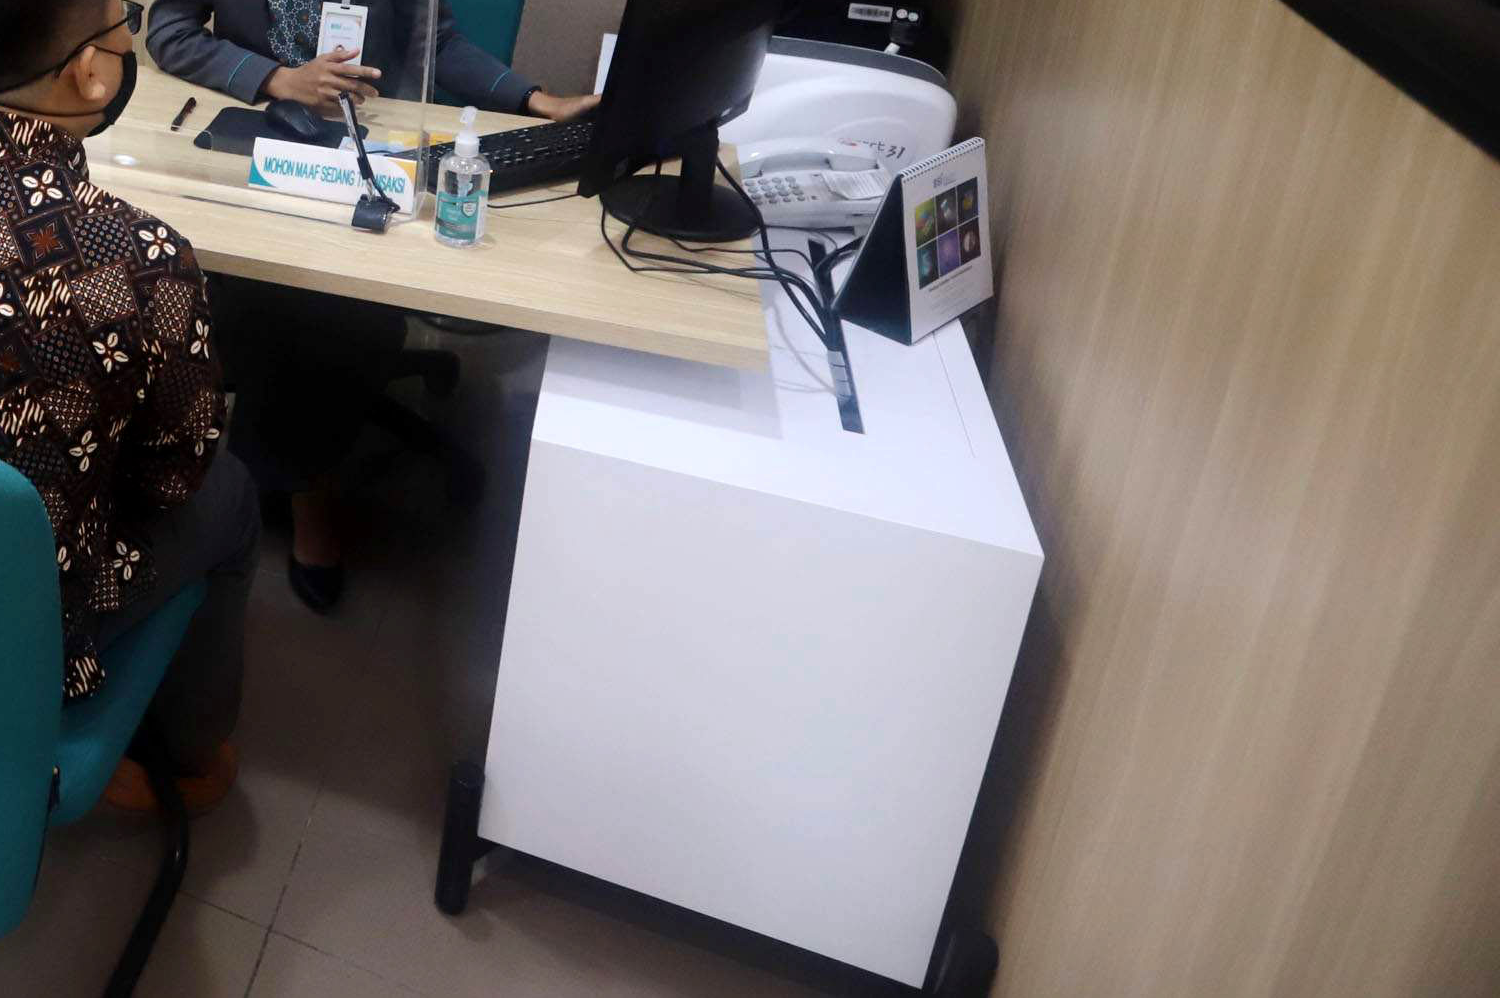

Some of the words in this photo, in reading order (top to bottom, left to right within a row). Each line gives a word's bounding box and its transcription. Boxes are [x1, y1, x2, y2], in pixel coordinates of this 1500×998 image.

[263, 156, 293, 176] MOHON
[294, 161, 321, 180] MAAF
[321, 165, 355, 186] SEDANG
[357, 169, 406, 194] TNSAKSI
